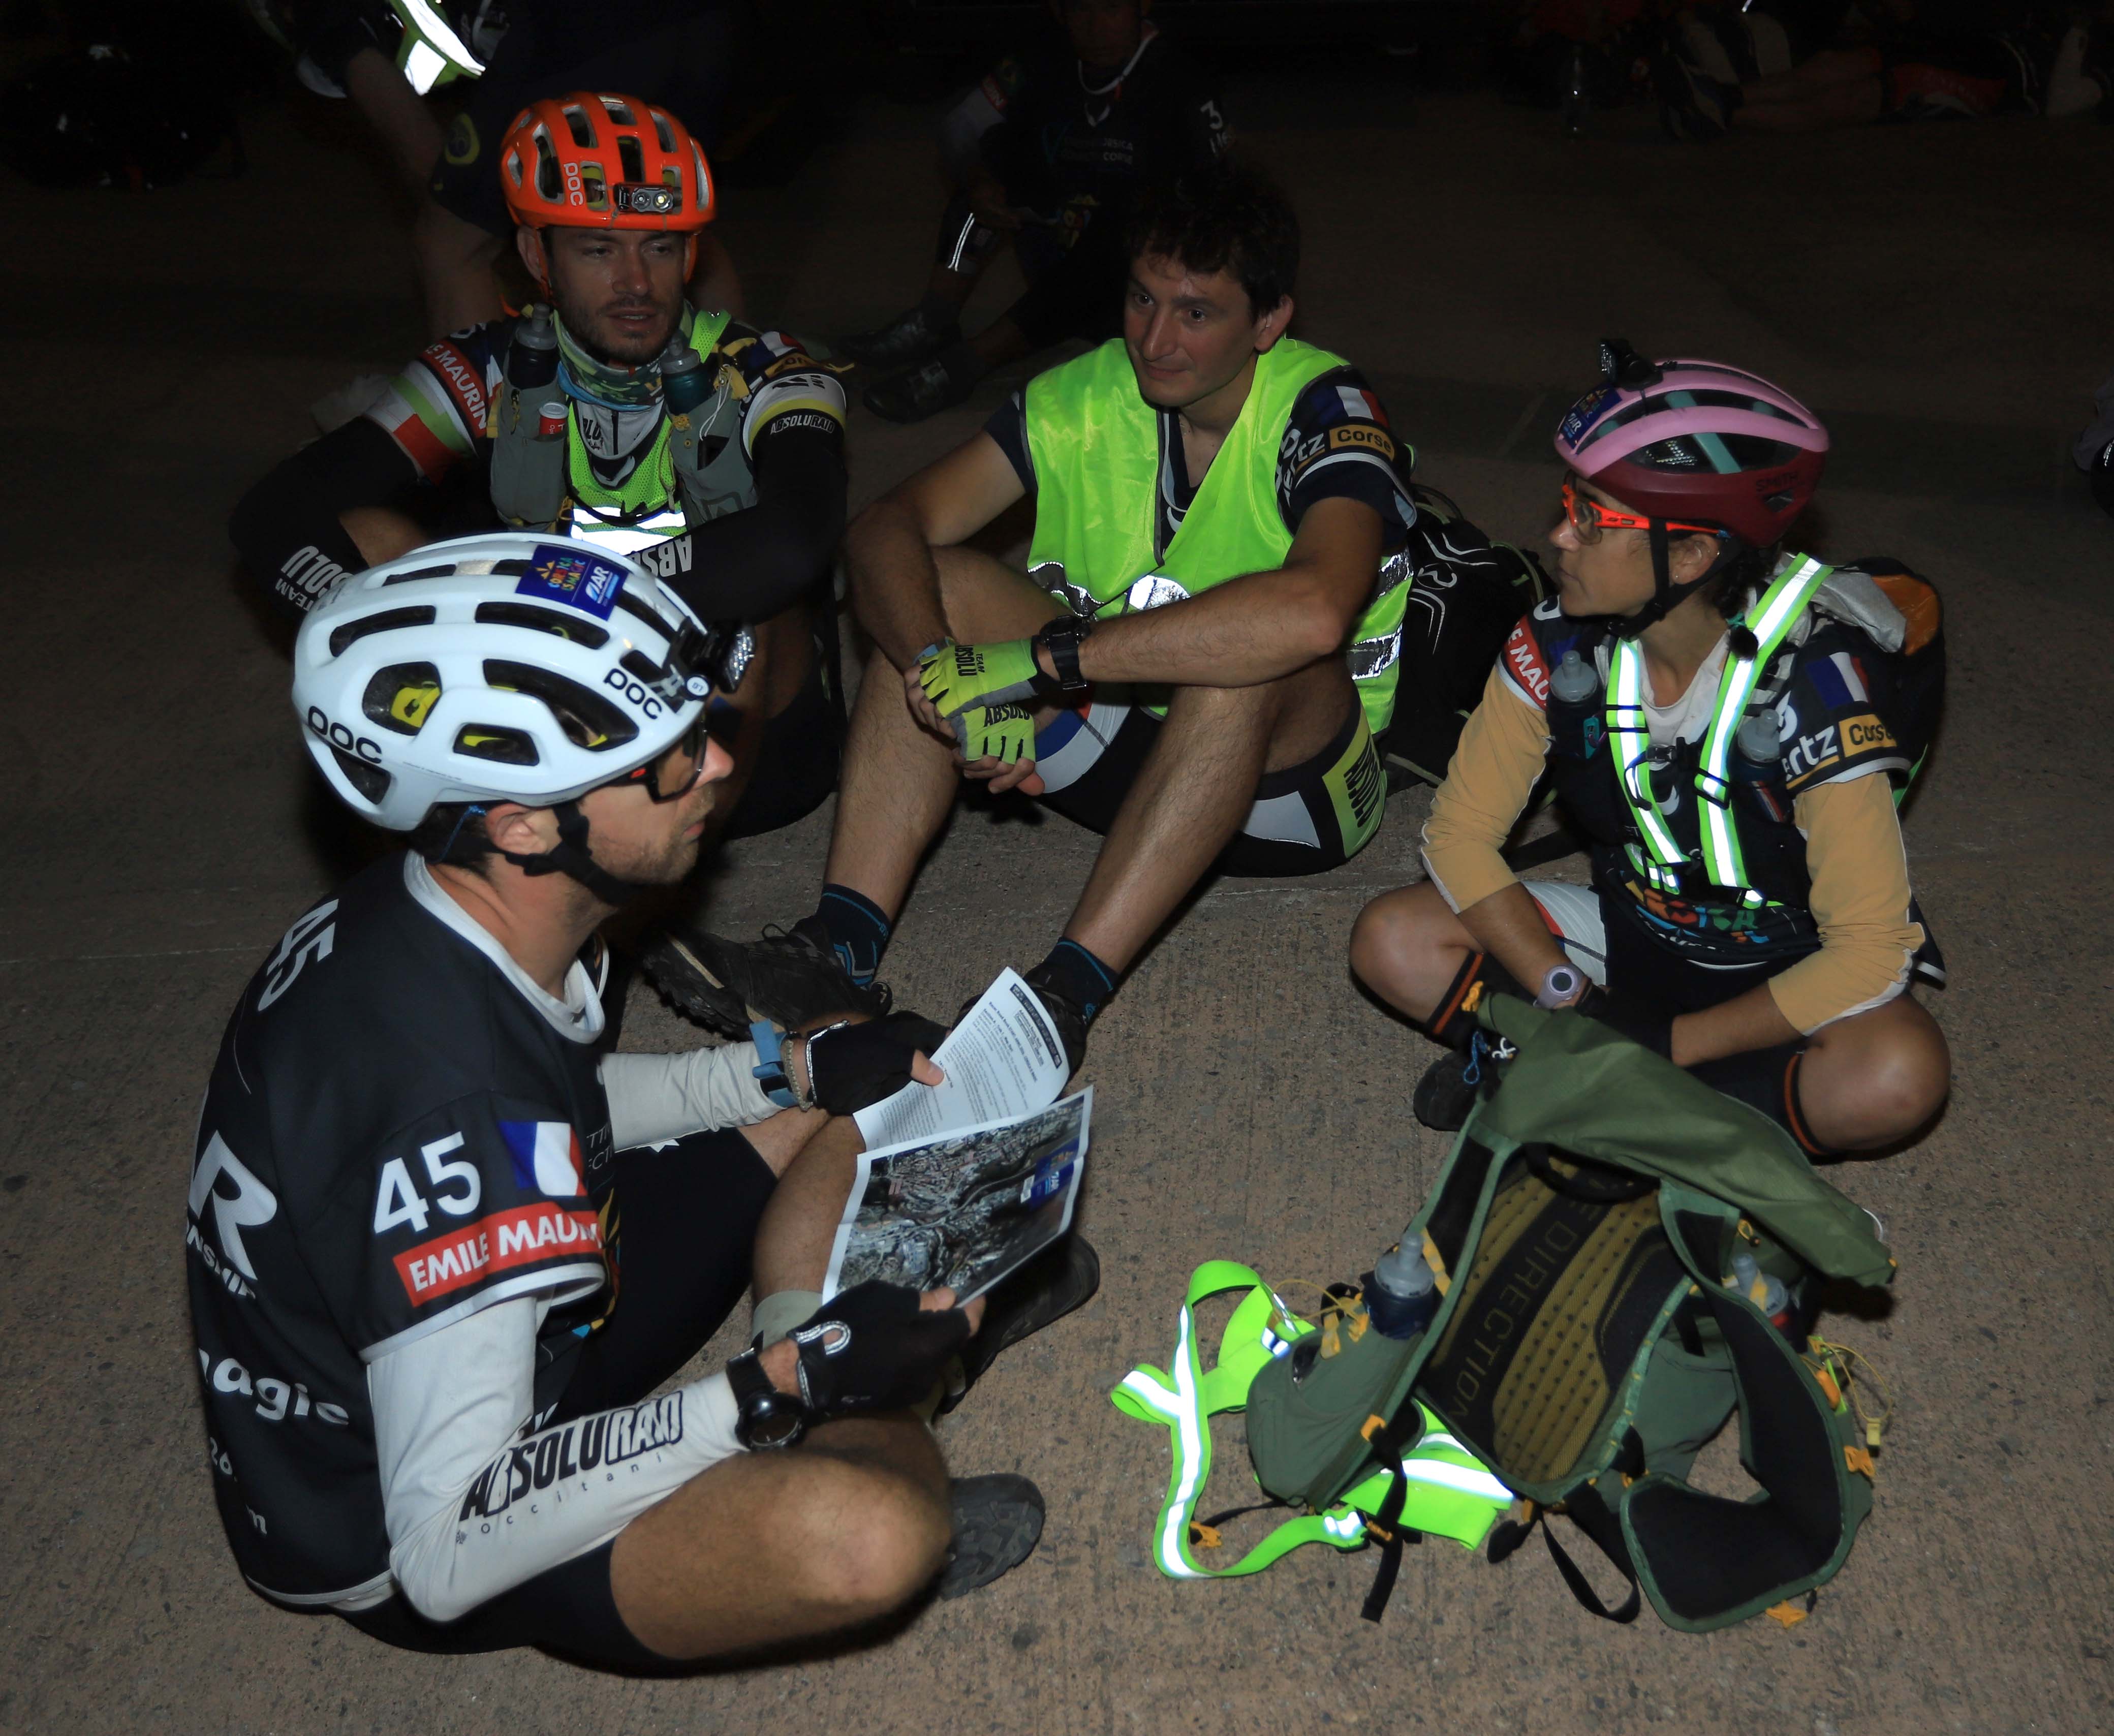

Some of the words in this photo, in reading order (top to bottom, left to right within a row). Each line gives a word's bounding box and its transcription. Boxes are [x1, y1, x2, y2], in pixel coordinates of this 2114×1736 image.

[434, 350, 487, 429] MAURIN
[769, 415, 835, 436] ABSOLURAID
[1336, 429, 1392, 453] Corse
[275, 578, 314, 611] TEAM
[976, 653, 985, 673] TEAM
[372, 1130, 482, 1235] 45
[409, 1231, 490, 1292] EMILE
[198, 1347, 350, 1426] agic
